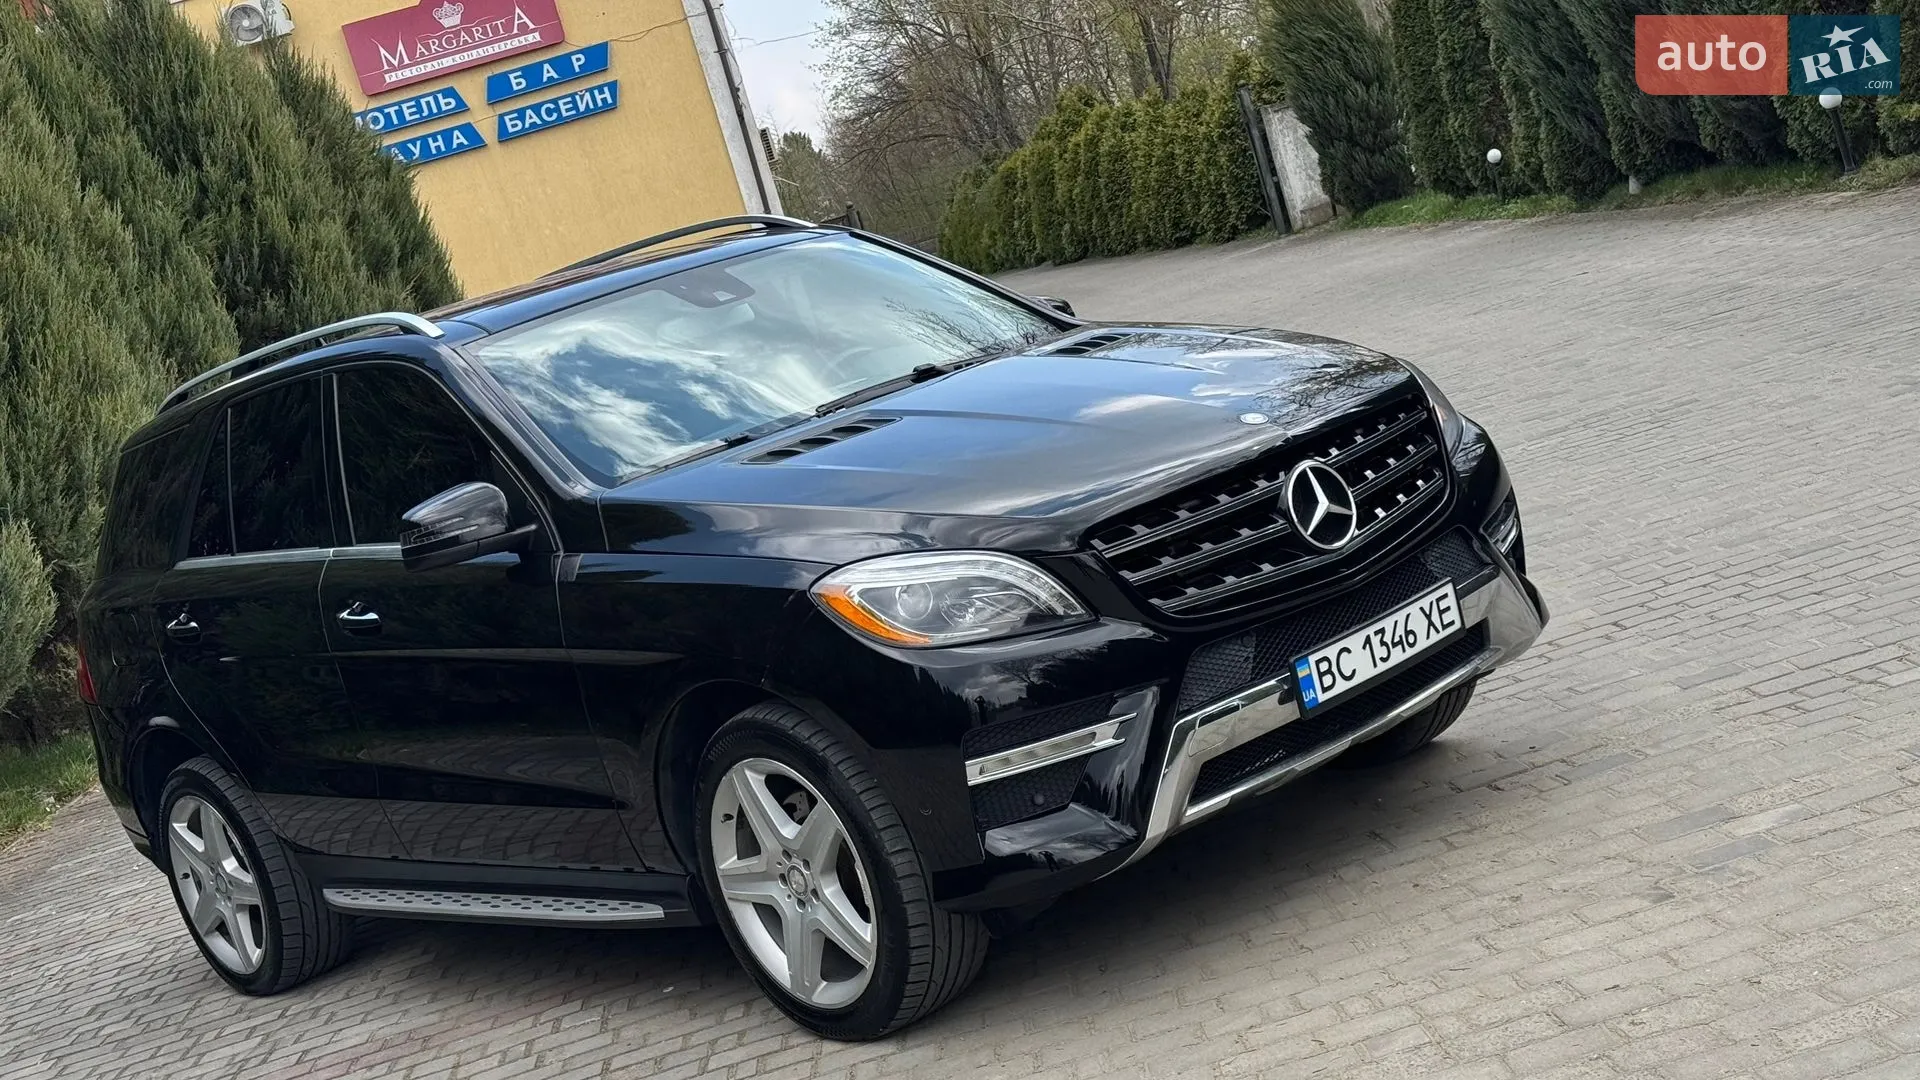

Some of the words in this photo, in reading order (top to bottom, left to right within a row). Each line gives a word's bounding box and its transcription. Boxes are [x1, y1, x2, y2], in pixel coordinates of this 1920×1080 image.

[370, 2, 537, 71] MARGARITA
[508, 53, 586, 91] БАР
[503, 86, 613, 133] БАСЕЙН
[391, 129, 469, 163] АУНА
[1314, 646, 1357, 694] BC
[1361, 612, 1418, 669] 1346
[1418, 592, 1456, 641] XE
[1302, 689, 1317, 702] UA
